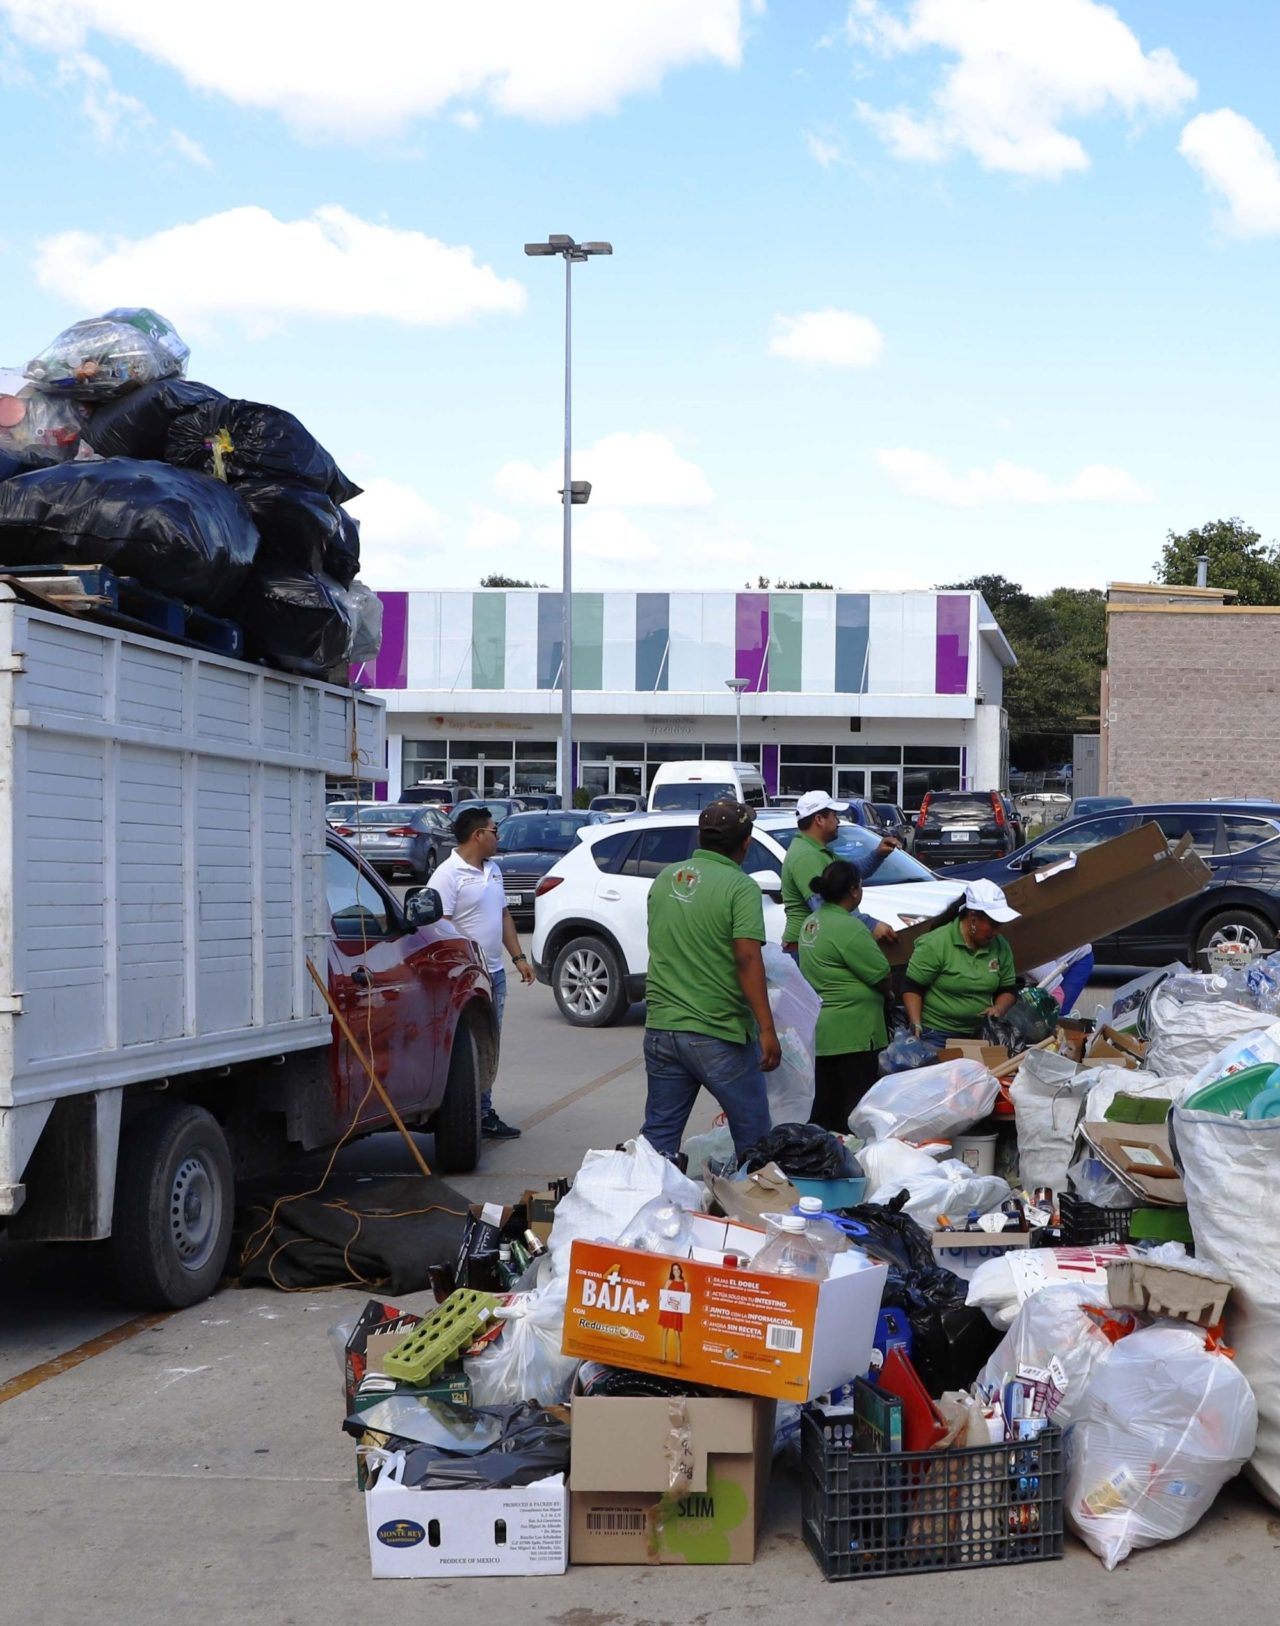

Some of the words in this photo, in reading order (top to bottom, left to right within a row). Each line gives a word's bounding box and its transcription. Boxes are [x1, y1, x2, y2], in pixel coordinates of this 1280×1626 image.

[738, 1280, 760, 1289] DOBLE
[755, 1297, 787, 1308] INTESTINO
[709, 1306, 730, 1316] JUNTO
[747, 1313, 793, 1326] INFORMACIÓN
[579, 1318, 620, 1335] Redustat
[738, 1326, 762, 1336] RECETA
[677, 1497, 715, 1518] SLIM
[380, 1529, 406, 1539] MONTE
[407, 1529, 423, 1538] REY
